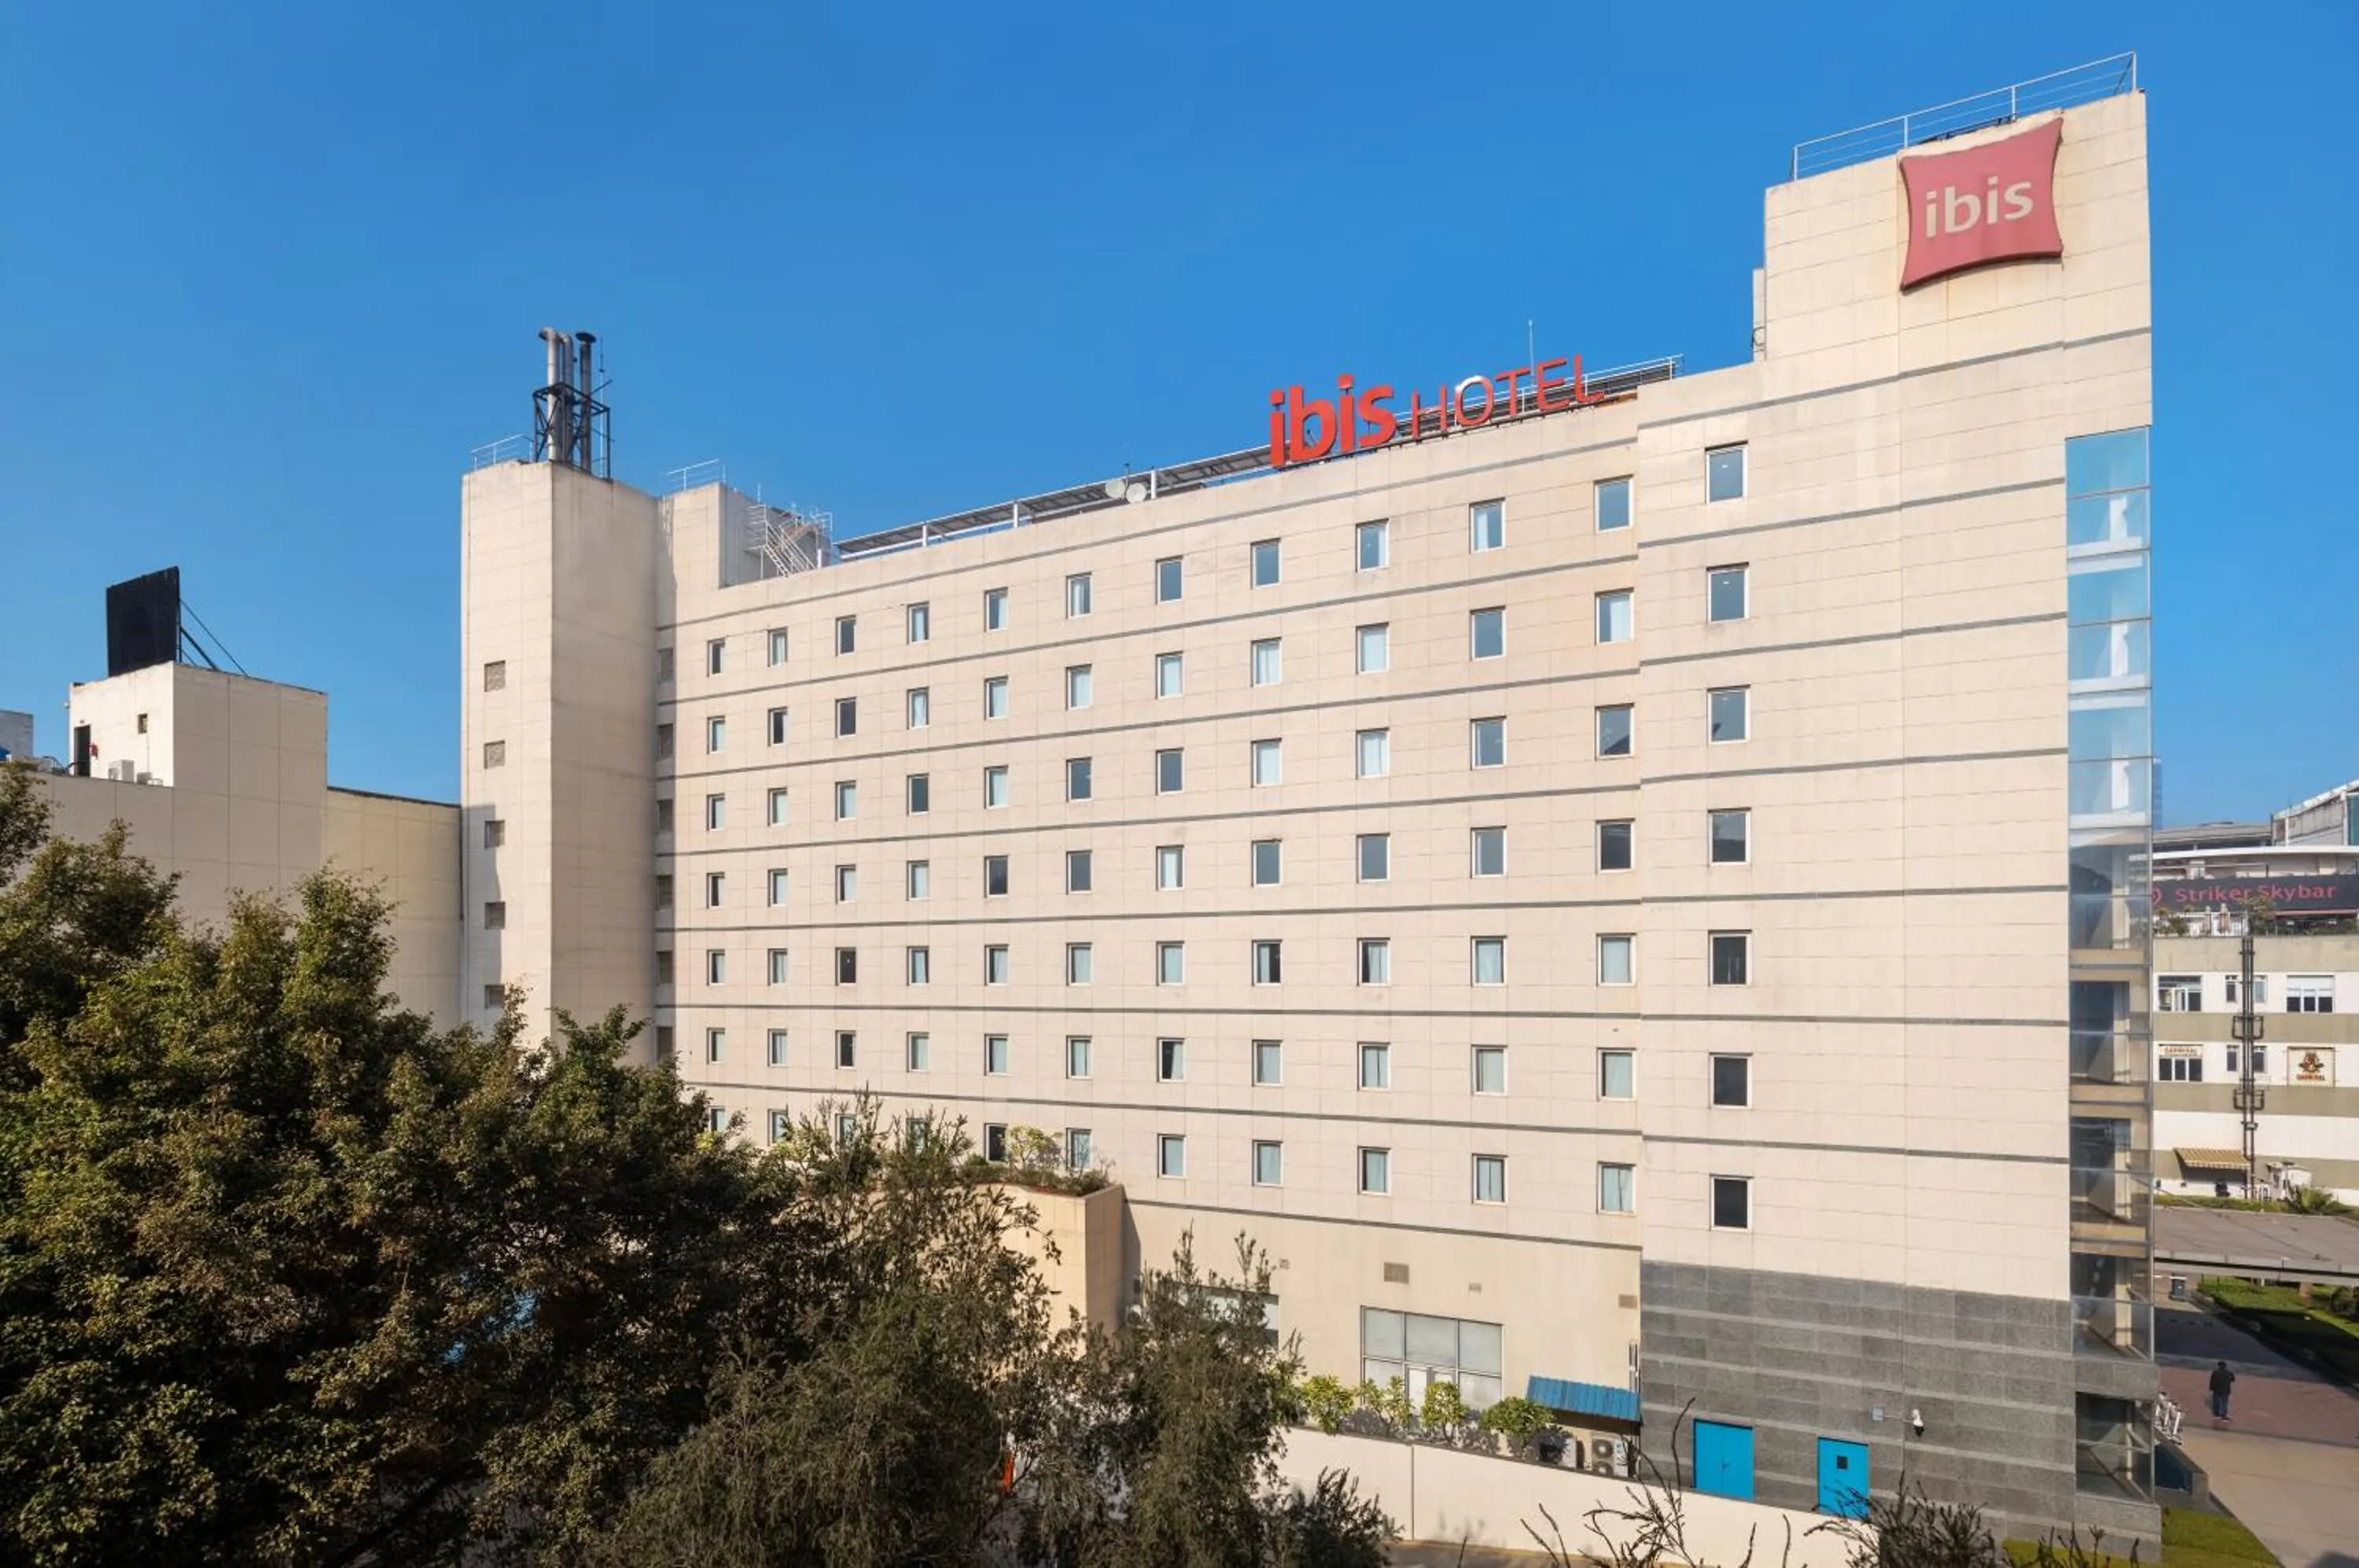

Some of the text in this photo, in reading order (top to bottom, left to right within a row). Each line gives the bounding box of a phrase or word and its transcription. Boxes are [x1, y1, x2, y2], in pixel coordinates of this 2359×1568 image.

[1926, 175, 2033, 238] ibis
[1269, 354, 1605, 468] ibis HOTEL
[2174, 883, 2337, 903] Striker Skybar
